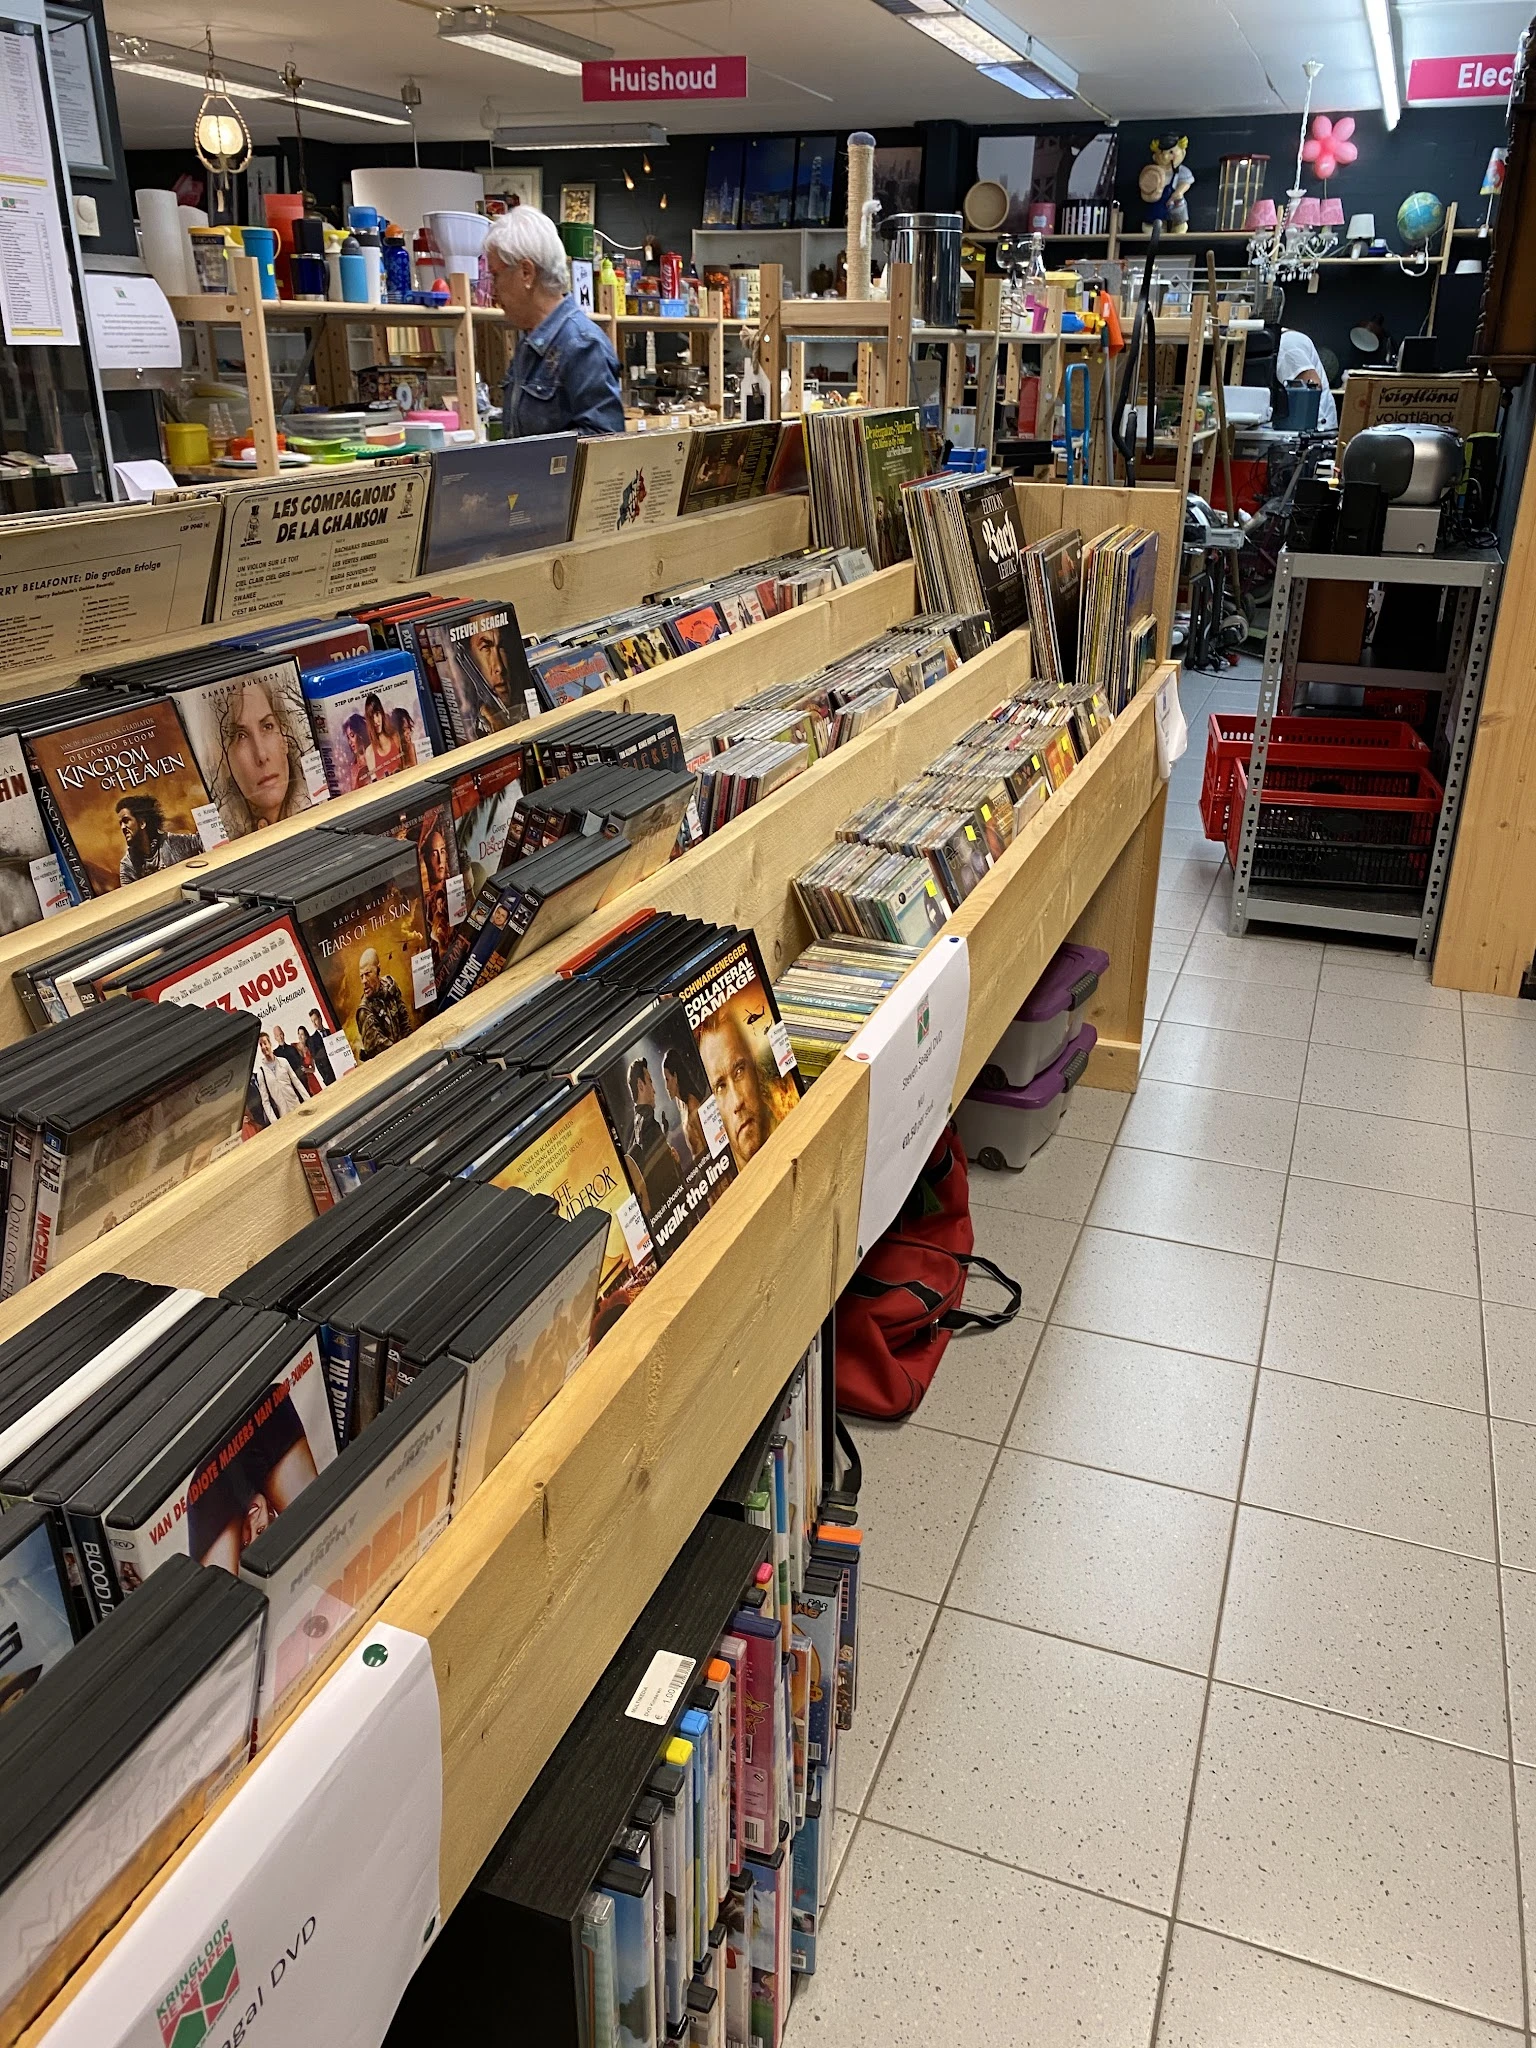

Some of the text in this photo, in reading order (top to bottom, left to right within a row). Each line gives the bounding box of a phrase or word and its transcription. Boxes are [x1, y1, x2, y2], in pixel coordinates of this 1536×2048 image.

[610, 63, 717, 92] Huishoud
[272, 482, 397, 520] LES COMPAGNONS
[980, 492, 1005, 515] EDITION
[276, 507, 389, 544] DE LA CHANSON
[22, 575, 82, 593] BELAFONTE:
[85, 572, 99, 582] Die
[102, 566, 132, 581] großen
[134, 560, 162, 575] Erfolge
[247, 561, 267, 571] VIOLON
[248, 576, 265, 585] CLAIR
[258, 599, 284, 612] CHANSON
[400, 629, 414, 650] EXIT
[449, 611, 509, 643] STEVEN SEAGAL
[201, 672, 280, 700] SANDRA BULLOCK
[432, 692, 452, 728] FLIGHT
[440, 677, 468, 741] MERCENARY
[69, 731, 156, 763] ORLANDO BLOOM
[56, 745, 150, 790] KINGDOM
[101, 752, 186, 791] OF HEAVEN
[333, 891, 395, 928] BRUCE WILLIS
[317, 899, 412, 958] TEARS OF THE SUN
[238, 958, 299, 1009] NOUS
[459, 953, 483, 985] JACK
[678, 942, 748, 1003] SCHWARZENEGGER
[80, 993, 95, 1002] DVD
[275, 986, 306, 1009] Vrouwen
[446, 977, 467, 1001] JILL
[684, 956, 753, 1018] COLLATERAL
[688, 965, 757, 1031] DAMAGE
[300, 1152, 317, 1160] DVD
[516, 1154, 535, 1173] WINNER
[539, 1134, 559, 1154] ACADEMY
[523, 1153, 547, 1178] INCLUDING
[546, 1144, 558, 1157] BEST
[144, 1176, 174, 1199] moment
[535, 1165, 556, 1186] ORIGINAL
[685, 1166, 699, 1184] reese
[649, 1183, 685, 1228] joaquin phoenix
[655, 1154, 730, 1247] walk the line
[329, 1355, 351, 1388] THE
[149, 1512, 173, 1546] VAN
[173, 1496, 187, 1520] DE
[188, 1459, 219, 1505] IDIOTE
[218, 1418, 255, 1471] MAKERS
[253, 1398, 274, 1428] VAN
[82, 1541, 112, 1600] BLOOD
[662, 1688, 676, 1704] 1,00
[270, 1915, 316, 1989] DVD
[156, 1918, 229, 2021] KRINGLOOP
[158, 2002, 179, 2032] DE
[179, 1930, 233, 2005] KEMPEN
